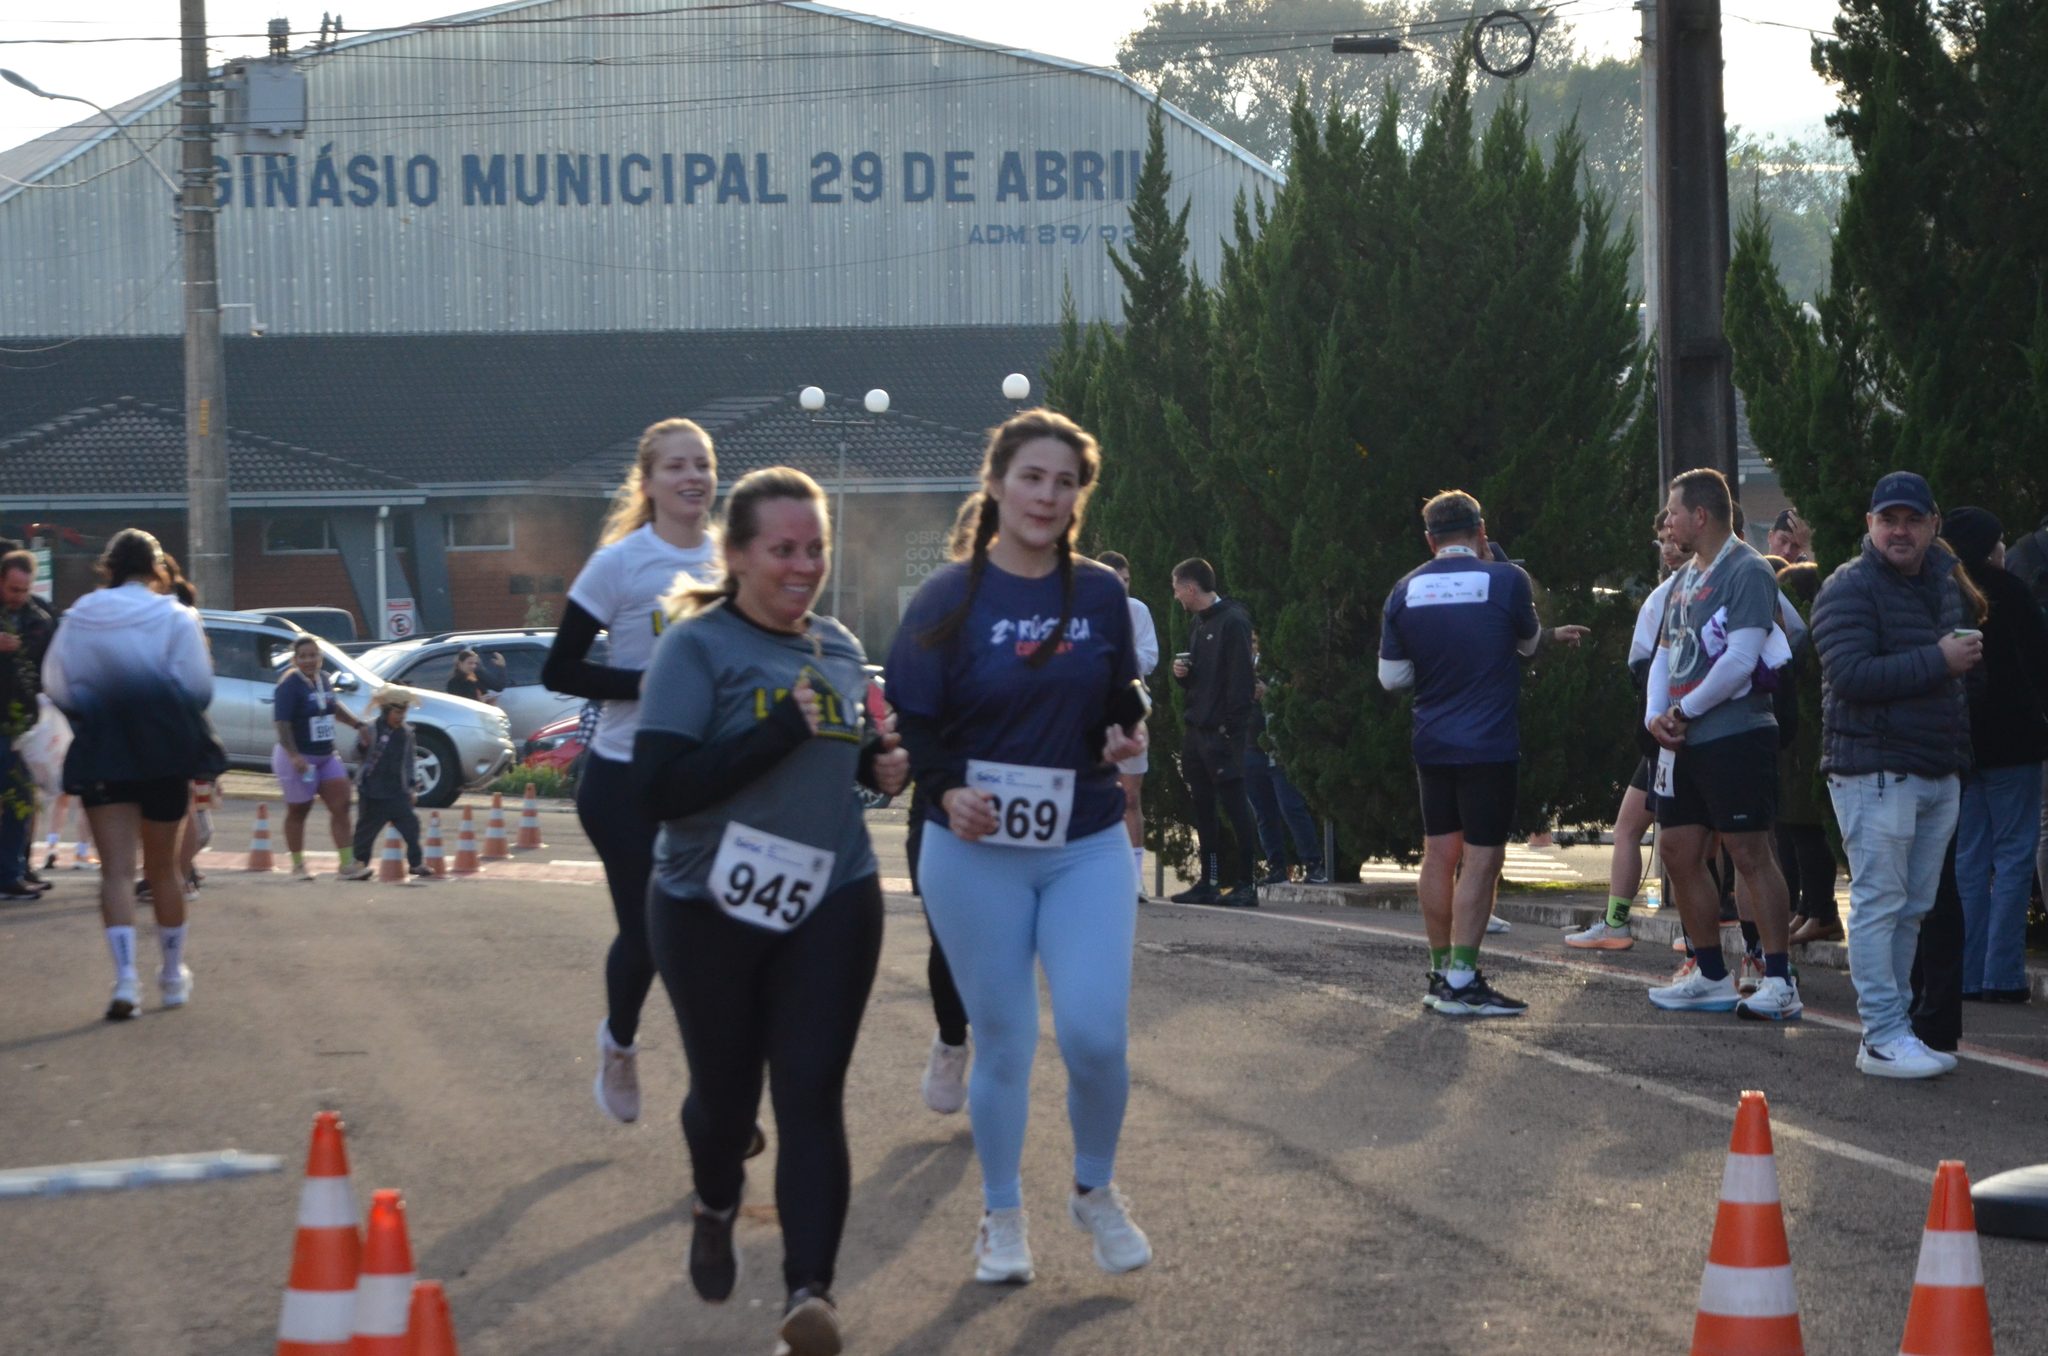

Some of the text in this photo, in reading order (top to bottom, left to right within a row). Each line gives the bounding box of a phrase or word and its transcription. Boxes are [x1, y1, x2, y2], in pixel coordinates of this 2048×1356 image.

[211, 141, 439, 207] GINÁSIO
[461, 151, 788, 207] MUNICIPAL
[810, 150, 884, 203] 29
[903, 150, 975, 202] DE
[725, 861, 813, 924] 945
